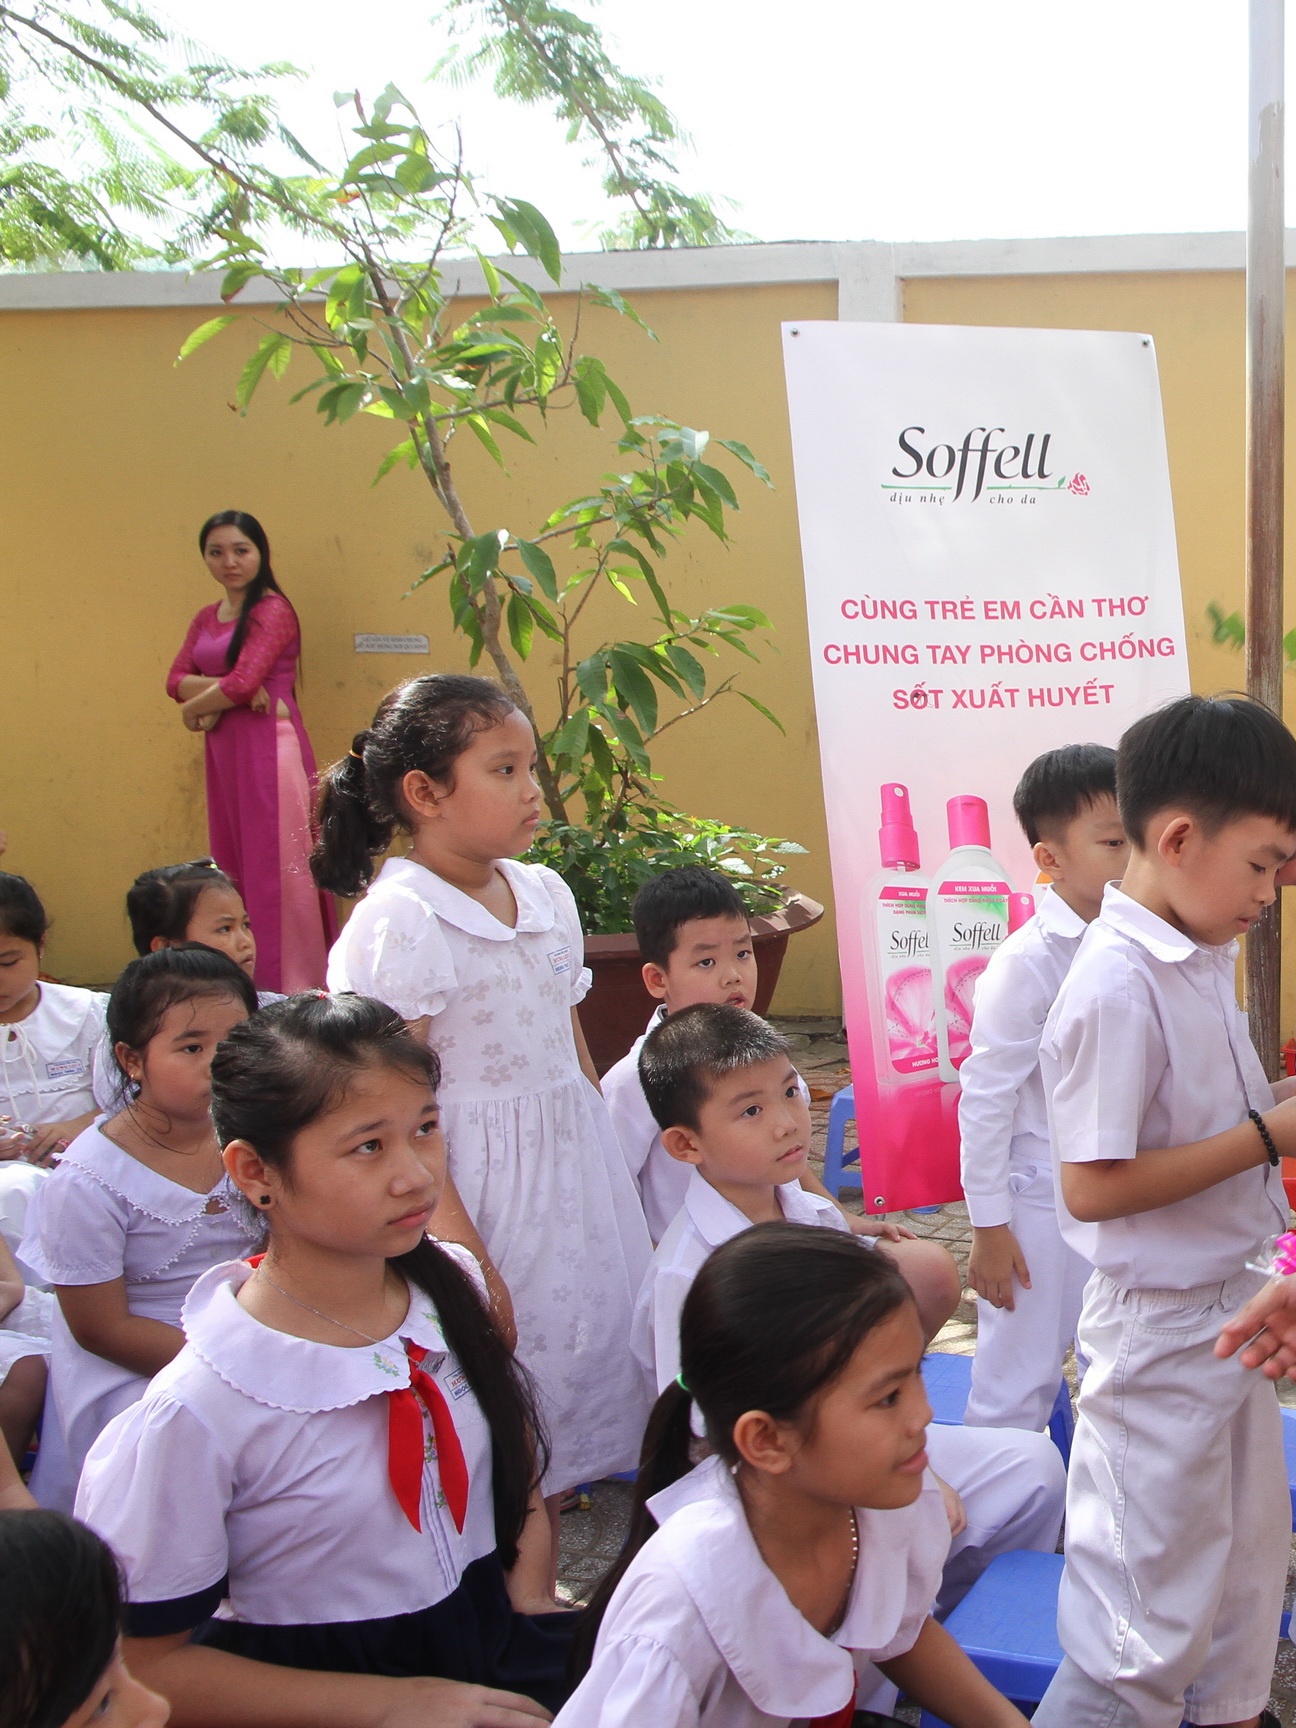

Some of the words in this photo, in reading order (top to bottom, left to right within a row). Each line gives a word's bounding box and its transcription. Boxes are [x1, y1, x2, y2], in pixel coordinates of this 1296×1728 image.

[892, 426, 1053, 503] Soffell
[890, 492, 912, 505] dịu
[920, 493, 945, 506] nhẹ
[989, 494, 1014, 504] cho
[1020, 494, 1036, 504] da
[841, 594, 918, 620] CÙNG
[924, 594, 976, 620] TRẺ
[983, 600, 1021, 620] EM
[1029, 593, 1084, 620] CẦN
[1091, 595, 1149, 617] THƠ
[823, 643, 919, 665] CHUNG
[926, 644, 972, 665] TAY
[979, 639, 1072, 664] PHÒNG
[1080, 632, 1175, 661] CHỐNG
[893, 681, 944, 710] SỐT
[951, 681, 1020, 709] XUẤT
[1028, 677, 1115, 708] HUYẾT
[890, 930, 929, 957] Soffel
[953, 922, 1000, 949] Soffell
